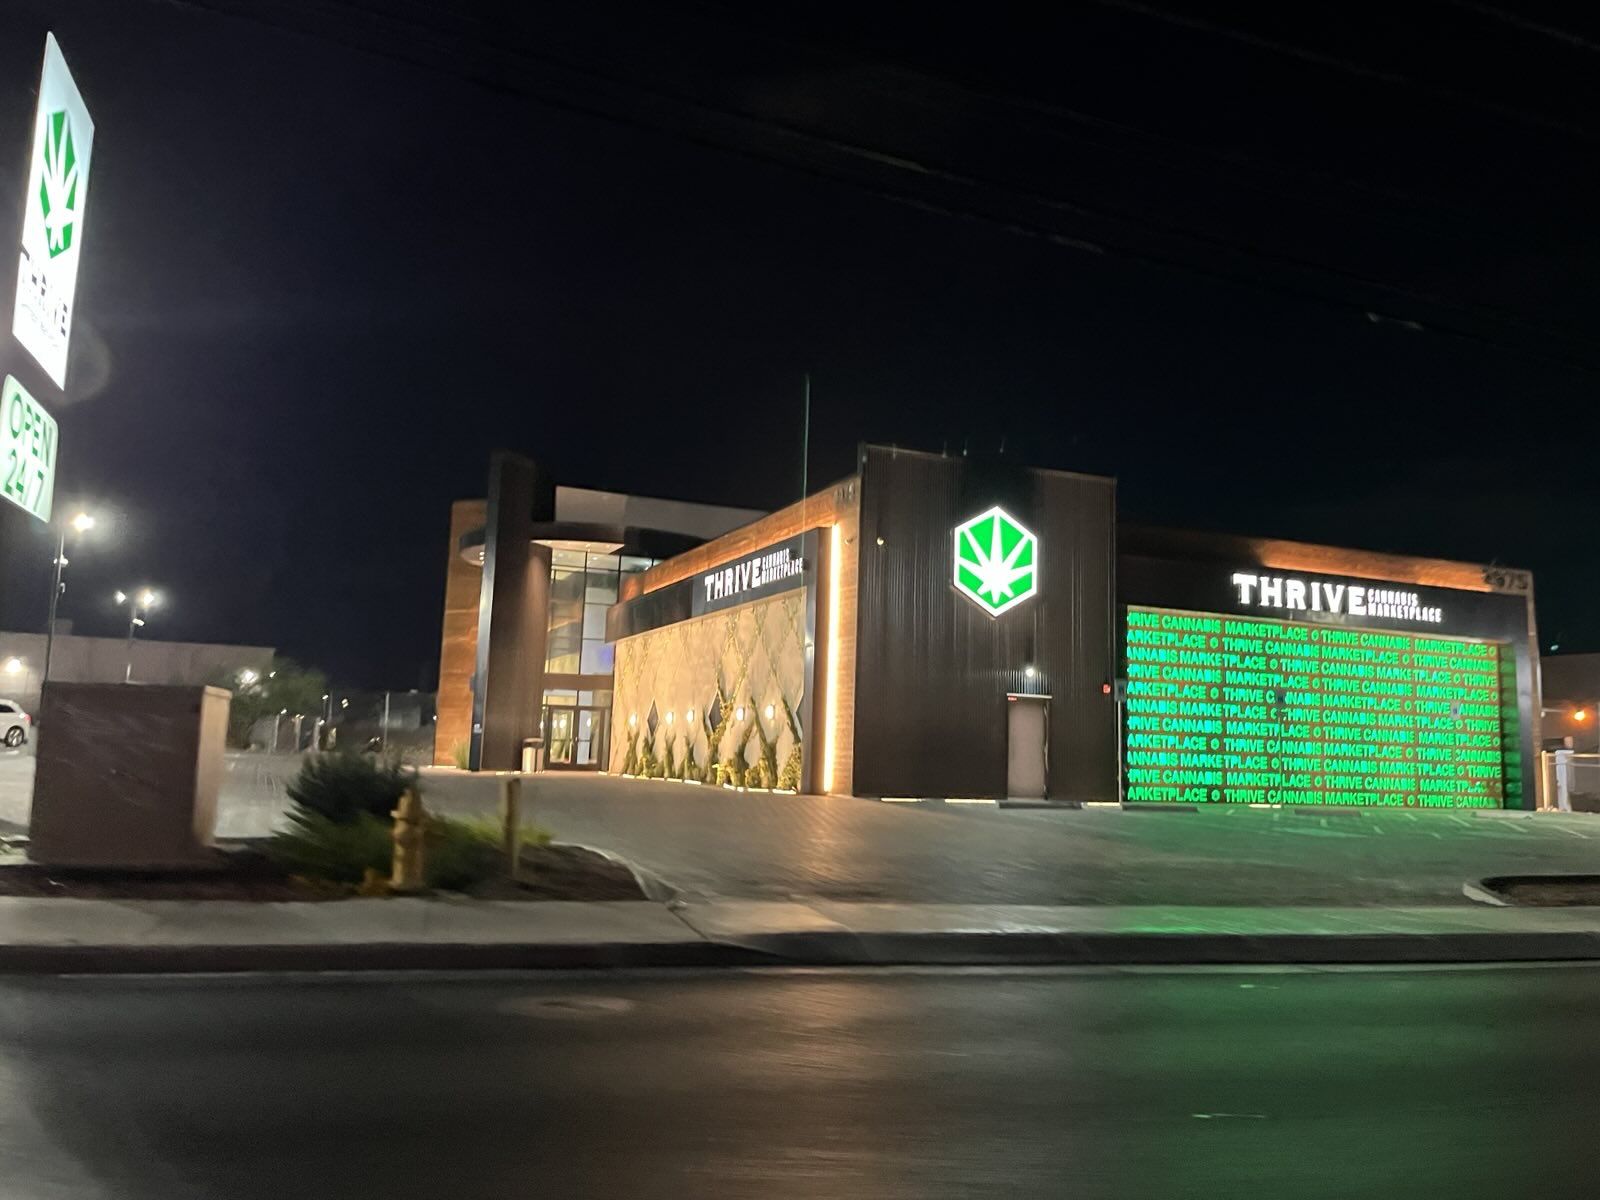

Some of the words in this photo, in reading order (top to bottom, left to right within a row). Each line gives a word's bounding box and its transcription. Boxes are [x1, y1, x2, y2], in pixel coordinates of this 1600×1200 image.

[10, 391, 53, 468] OPEN
[704, 557, 762, 602] THRIVE
[1232, 573, 1366, 615] THRIVE
[1368, 589, 1418, 606] CANNABIS
[1368, 604, 1442, 622] MARKETPLACE
[1266, 691, 1320, 706] CNNABIS
[1459, 704, 1498, 717] ANNABIS
